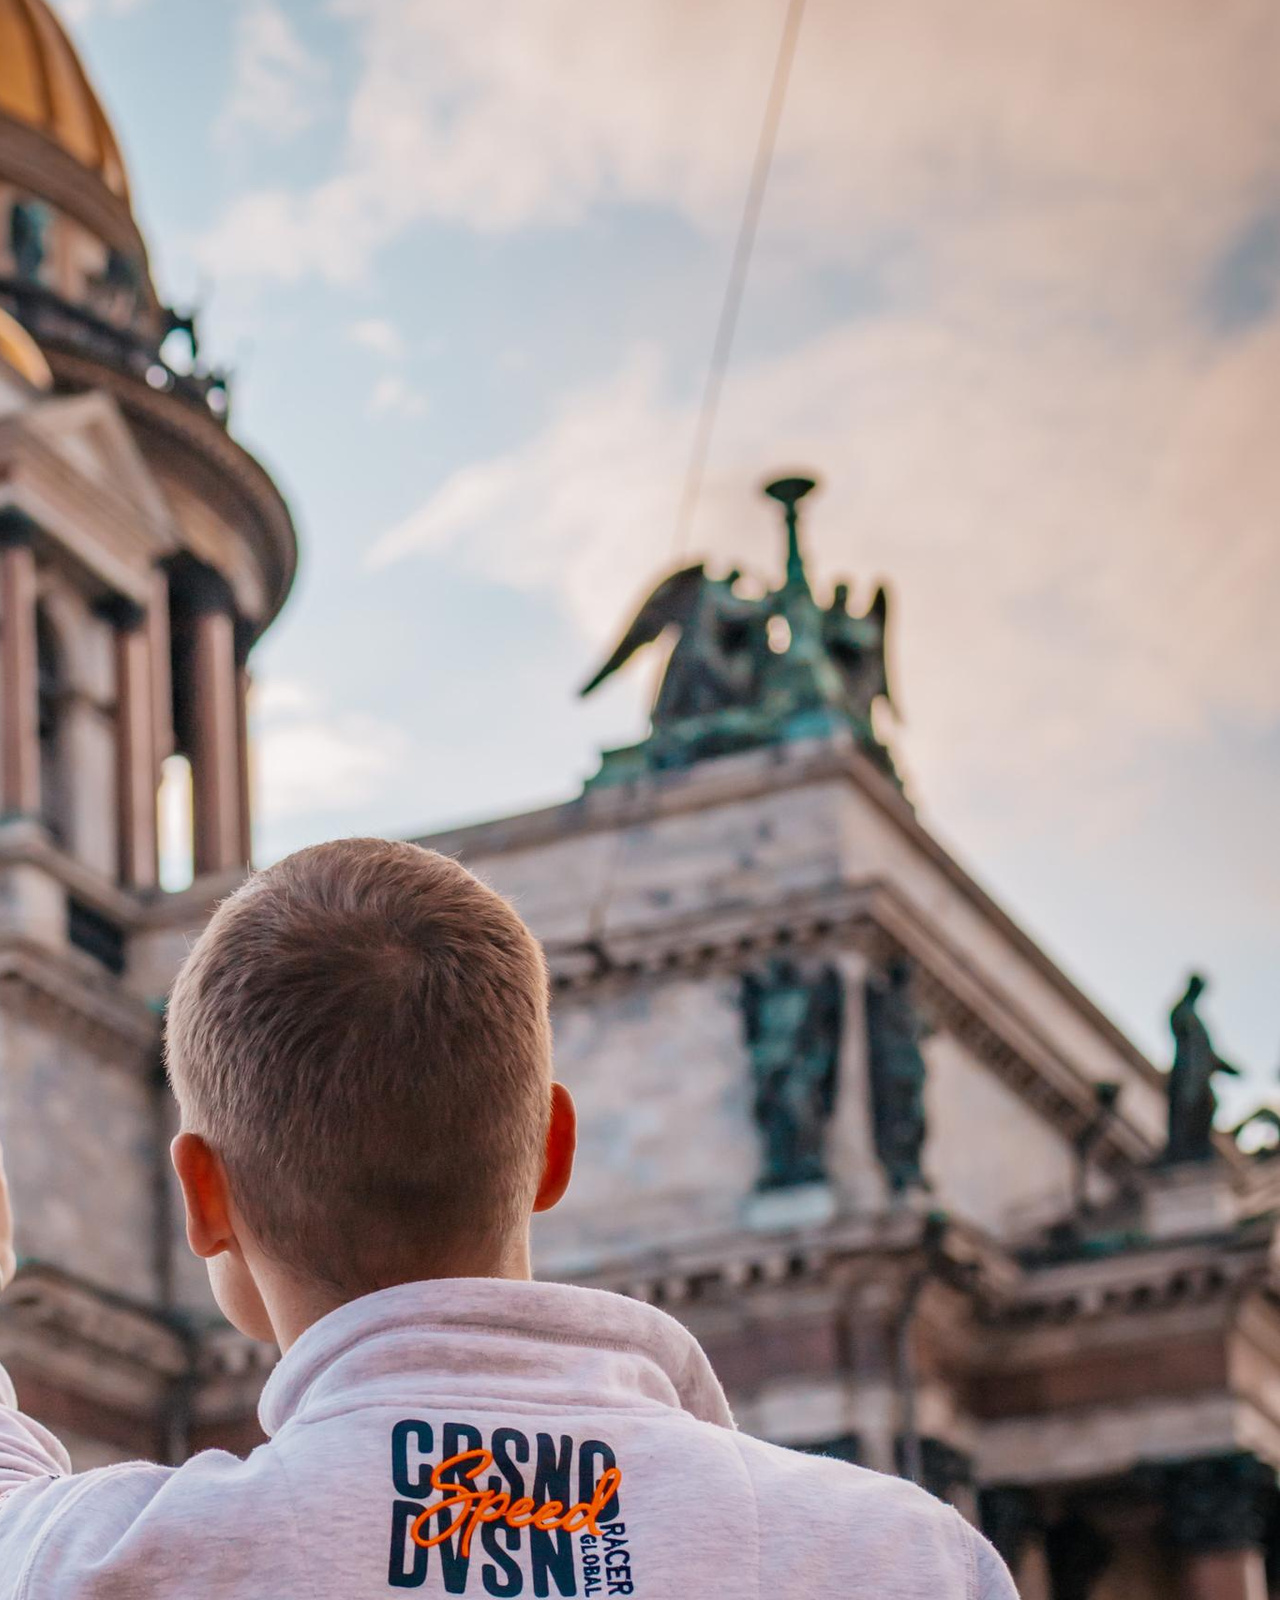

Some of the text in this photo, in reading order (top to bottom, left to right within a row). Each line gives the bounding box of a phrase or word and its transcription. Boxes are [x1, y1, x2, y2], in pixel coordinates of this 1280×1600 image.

[411, 1449, 621, 1557] Speed
[388, 1500, 577, 1598] DVSN
[580, 1534, 602, 1598] GLOBAL
[600, 1522, 634, 1596] RACER
